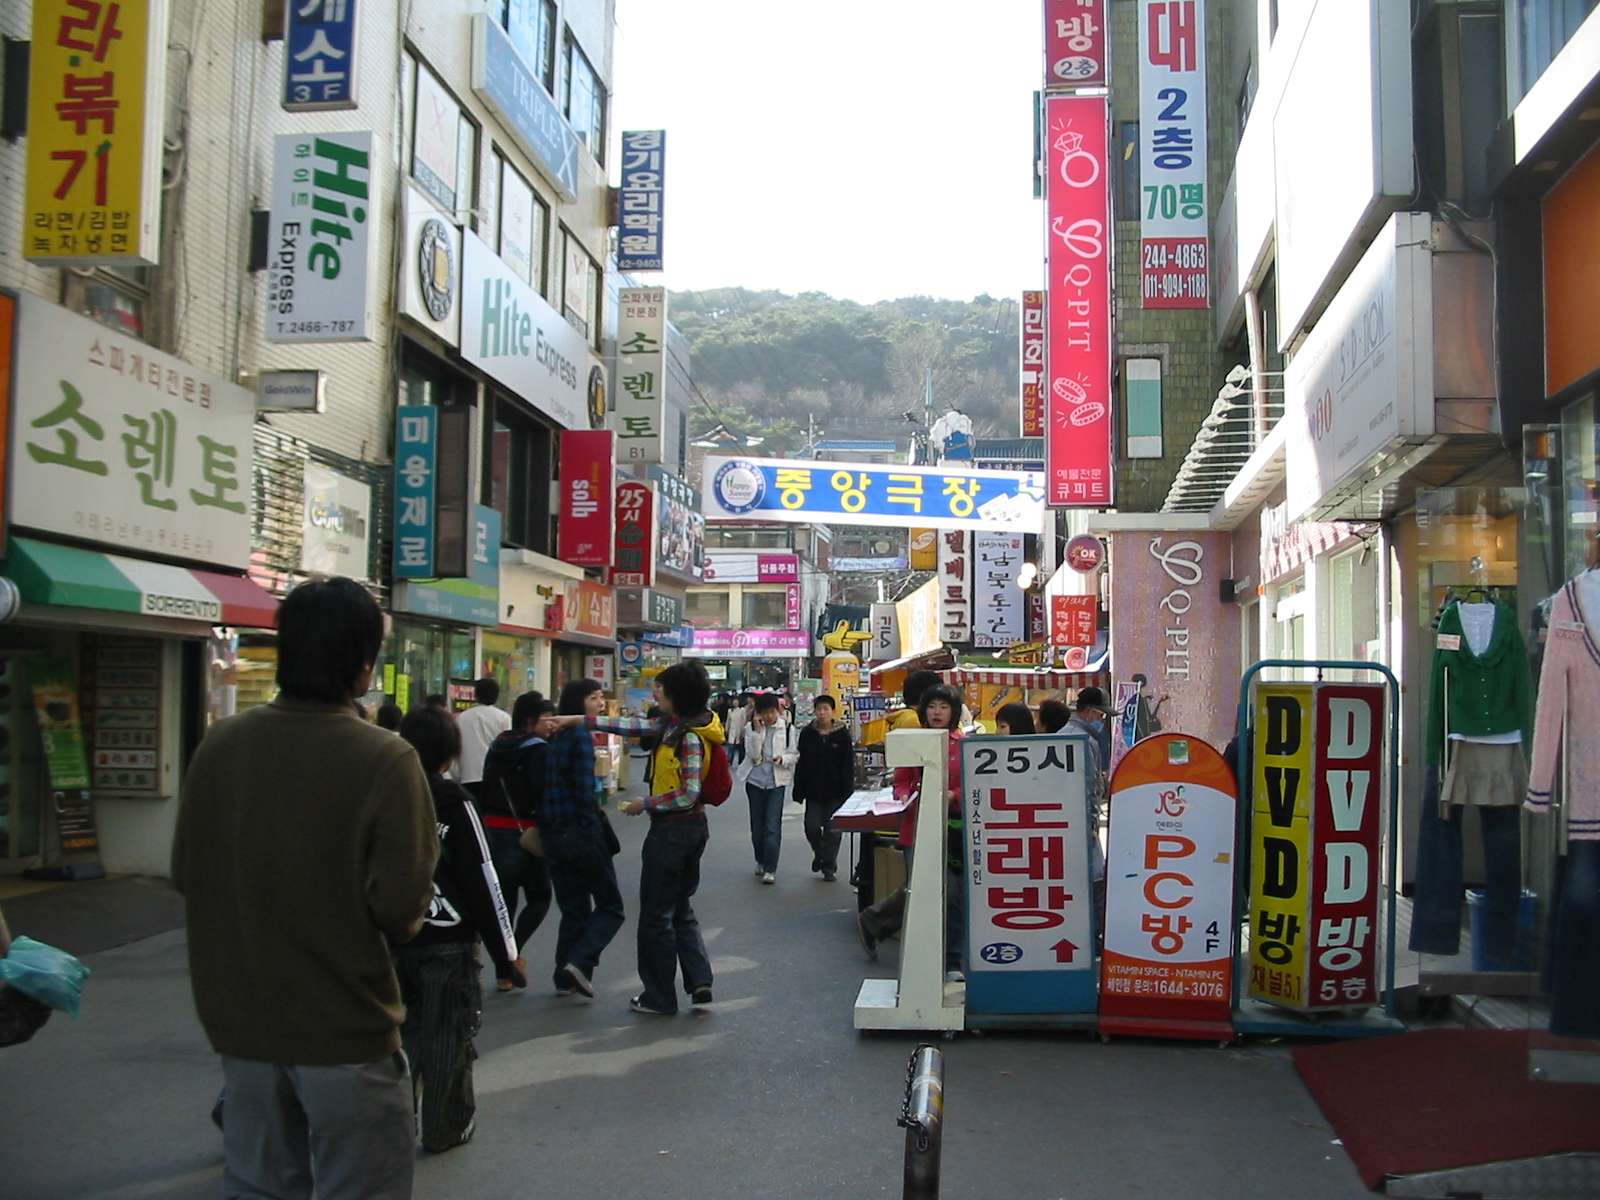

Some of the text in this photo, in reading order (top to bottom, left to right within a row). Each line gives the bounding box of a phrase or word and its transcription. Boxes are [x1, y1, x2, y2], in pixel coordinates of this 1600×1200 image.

[1056, 0, 1098, 52] 방
[1148, 1, 1197, 72] 대
[293, 85, 342, 102] 3F
[1060, 57, 1095, 76] 2층
[1151, 88, 1193, 170] 2층
[291, 144, 310, 207] 하이트
[1143, 183, 1204, 220] 70평
[308, 137, 370, 280] Hite
[278, 222, 301, 315] Express
[1144, 243, 1206, 269] 244-4863
[1144, 272, 1206, 299] 011-9094-1188
[479, 278, 532, 359] Hite
[1063, 264, 1092, 352] Q-PIT
[88, 339, 212, 410] 스파게티전문점
[536, 326, 578, 391] Express
[619, 330, 660, 439] 소렌토
[26, 379, 247, 515] 소렌토
[629, 447, 646, 459] B1
[398, 416, 429, 567] 미용재료
[775, 467, 982, 518] 중앙극장
[1056, 482, 1104, 499] 큐피트
[146, 593, 219, 618] SORRENTO
[880, 616, 892, 648] FILA
[1160, 590, 1192, 681] Q-PIT
[974, 744, 1075, 775] 25시
[984, 787, 1074, 931] 노래방
[1258, 695, 1302, 966] DVD방
[1317, 697, 1371, 971] DVD방
[1141, 834, 1197, 955] PC방
[985, 945, 1019, 961] 2층
[1319, 977, 1367, 1000] 5층
